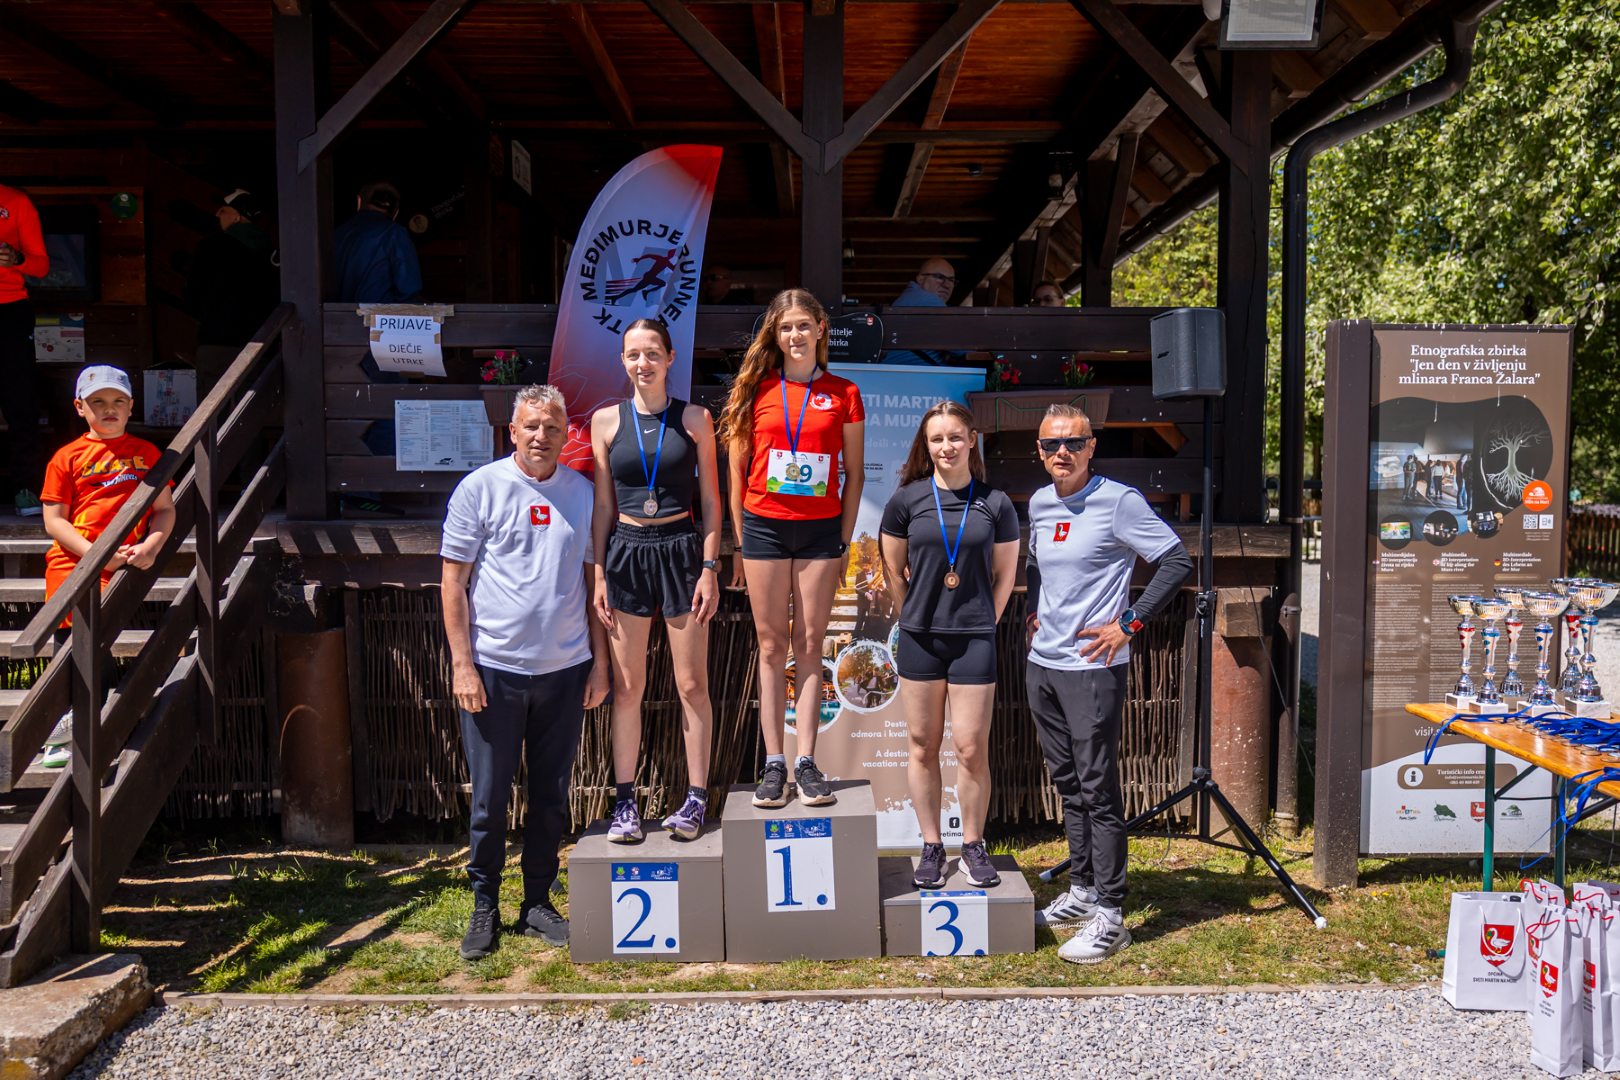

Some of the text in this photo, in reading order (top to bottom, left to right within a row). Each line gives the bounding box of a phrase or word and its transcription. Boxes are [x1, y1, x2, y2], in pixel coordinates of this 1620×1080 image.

[580, 219, 683, 302] MEĐIMURJE
[380, 317, 432, 331] PRIJAVE
[592, 307, 622, 335] TK
[828, 327, 853, 338] titelje
[388, 343, 423, 354] DJEČJE
[828, 339, 849, 347] birka
[1410, 344, 1527, 359] Etnografska zbirka
[392, 357, 425, 366] UTRKE
[1437, 359, 1461, 370] den
[1463, 361, 1470, 370] v
[1473, 359, 1527, 373] življenju
[1399, 373, 1448, 385] mlinara
[1450, 373, 1493, 385] Franca
[861, 394, 880, 408] ETI
[884, 414, 923, 427] MUR
[864, 438, 889, 448] došli
[82, 455, 151, 477] SKATE
[851, 730, 882, 738] odmora
[888, 730, 908, 738] kvali
[883, 750, 909, 758] destin
[862, 759, 898, 768] vacation
[772, 845, 828, 907] 1.
[616, 887, 677, 948] 2.
[927, 900, 985, 956] 3.
